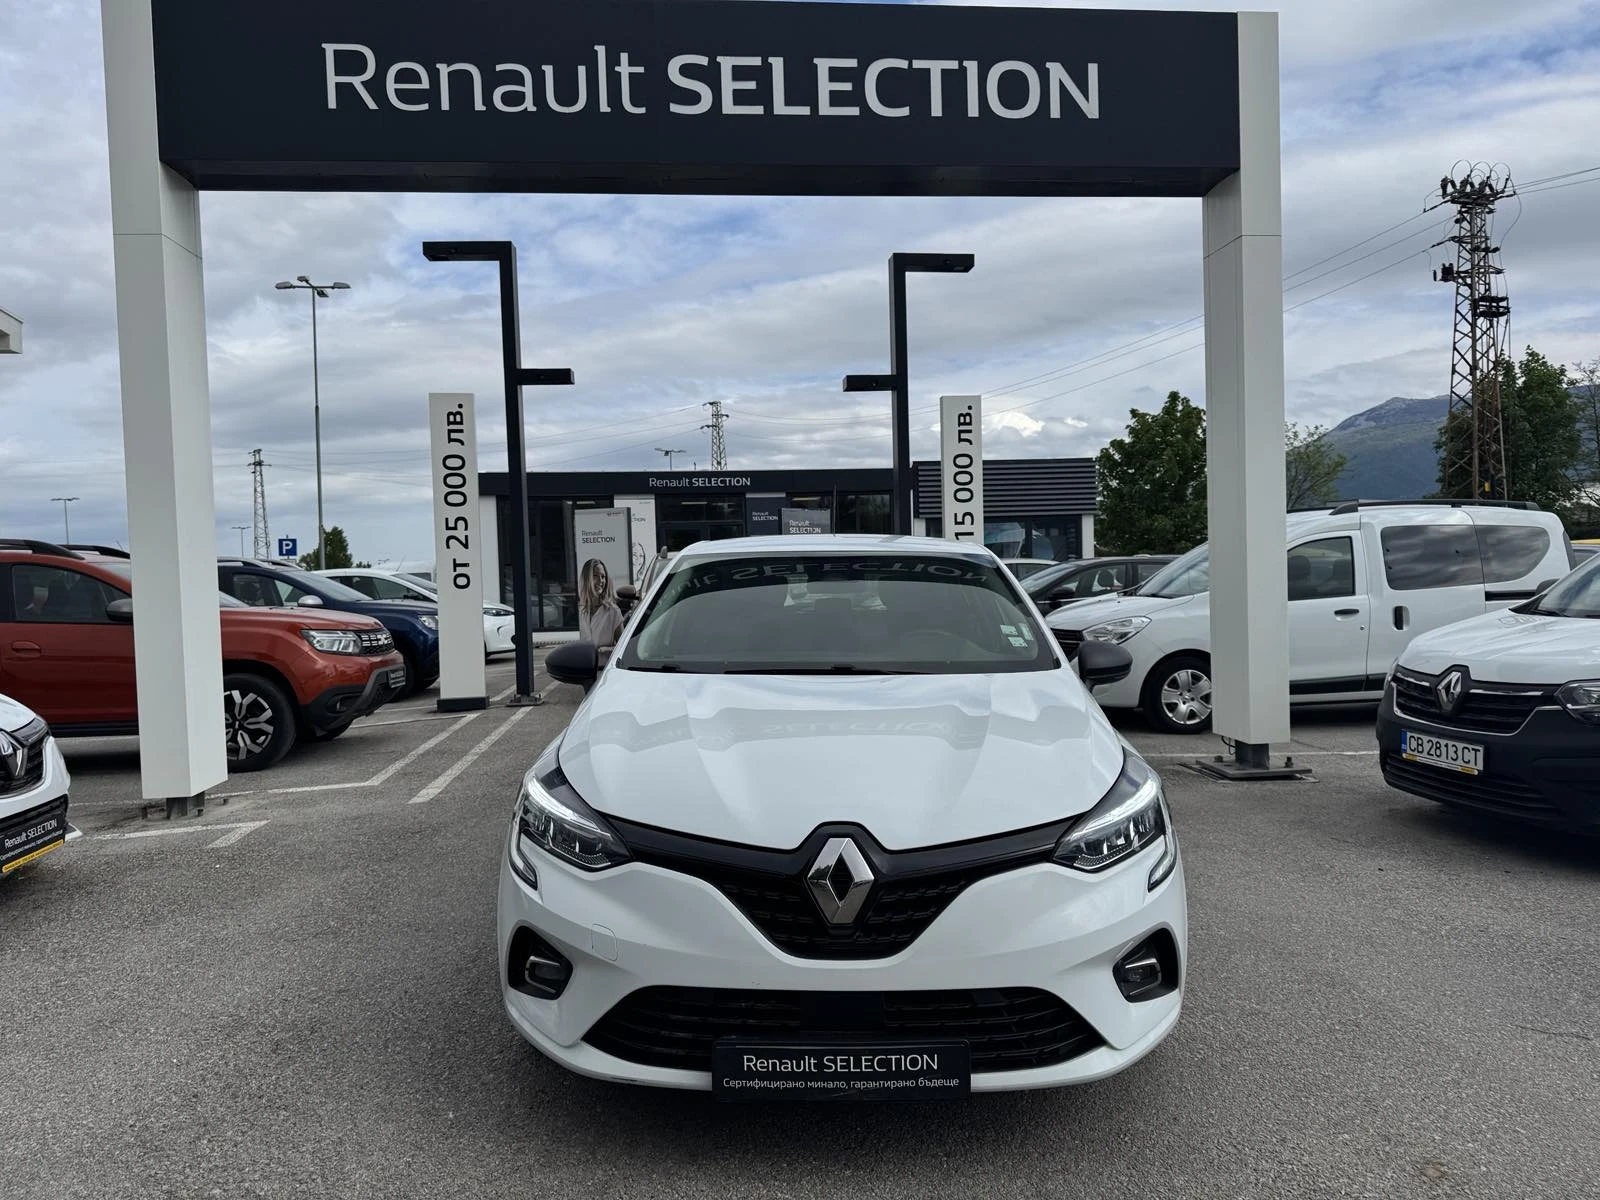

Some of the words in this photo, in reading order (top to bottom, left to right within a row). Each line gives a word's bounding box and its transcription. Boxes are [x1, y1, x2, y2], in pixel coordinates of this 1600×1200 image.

[321, 42, 646, 114] Renault
[667, 53, 1101, 120] SELECTION
[446, 403, 465, 446] лв.
[957, 405, 973, 446] лв.
[442, 454, 468, 507] 000
[649, 477, 690, 487] Renault
[692, 477, 751, 487] SELECTION
[952, 453, 974, 503] 000
[444, 516, 470, 550] 25
[581, 536, 616, 544] SELECTION
[953, 511, 975, 541] 15
[282, 540, 293, 555] P
[452, 557, 471, 590] от
[1408, 735, 1424, 754] CB
[1426, 739, 1459, 762] 2813
[1461, 746, 1481, 767] CT
[4, 831, 27, 849] Renault
[26, 818, 57, 840] SELECTION
[743, 1055, 818, 1072] Renault
[823, 1054, 938, 1072] SELECTION
[723, 1078, 805, 1090] Сертифицирано
[807, 1080, 849, 1090] минало,
[850, 1079, 916, 1090] гарантирано
[918, 1077, 960, 1089] бъдеще
